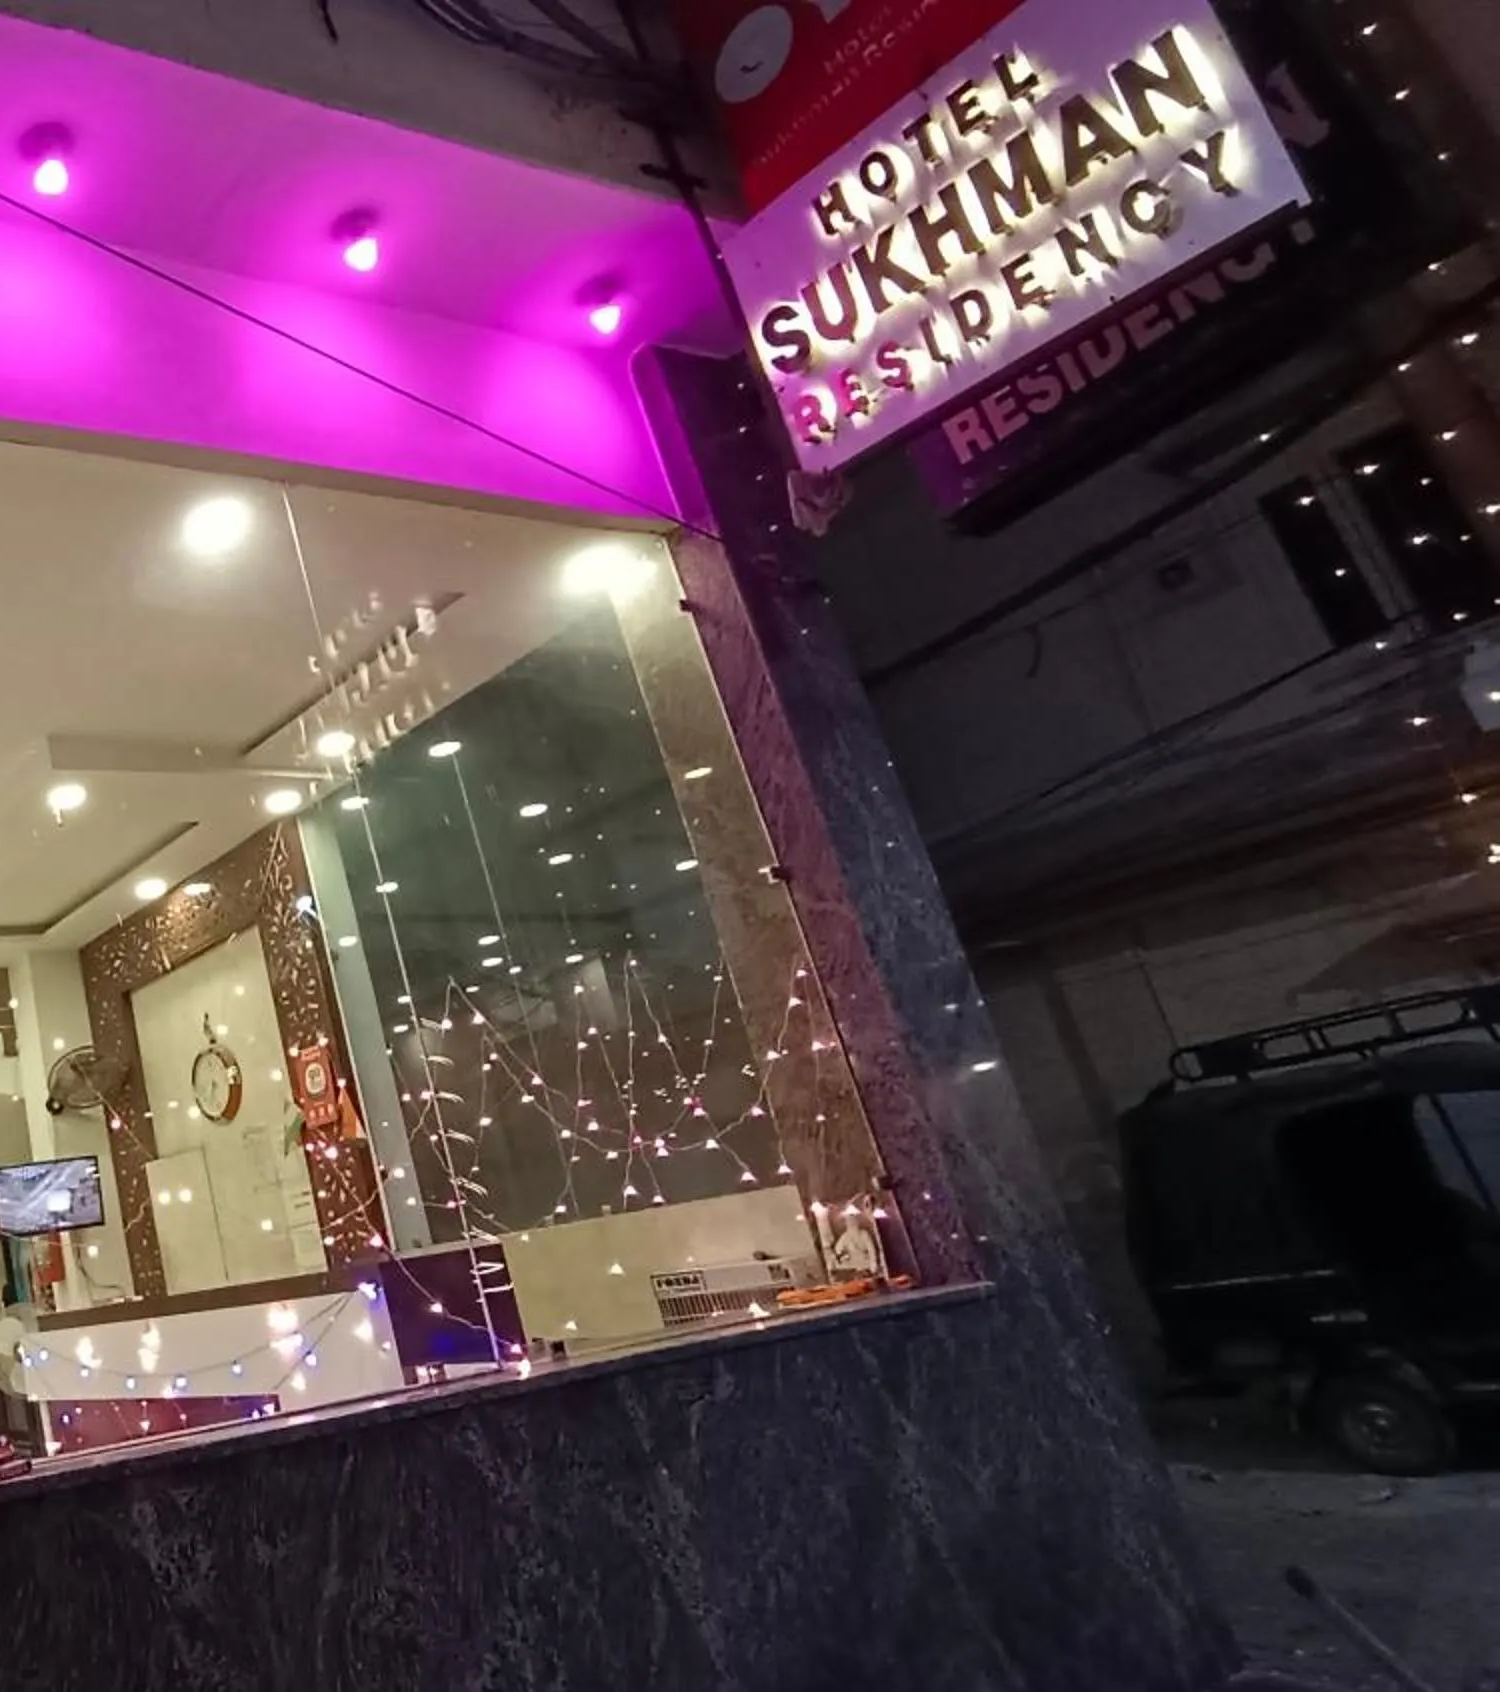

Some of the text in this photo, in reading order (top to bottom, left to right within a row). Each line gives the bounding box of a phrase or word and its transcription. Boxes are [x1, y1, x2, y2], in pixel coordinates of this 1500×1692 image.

[760, 28, 1208, 376] SUKHMAN
[794, 131, 1240, 444] RESIDENCY
[811, 50, 1038, 238] HOTEL
